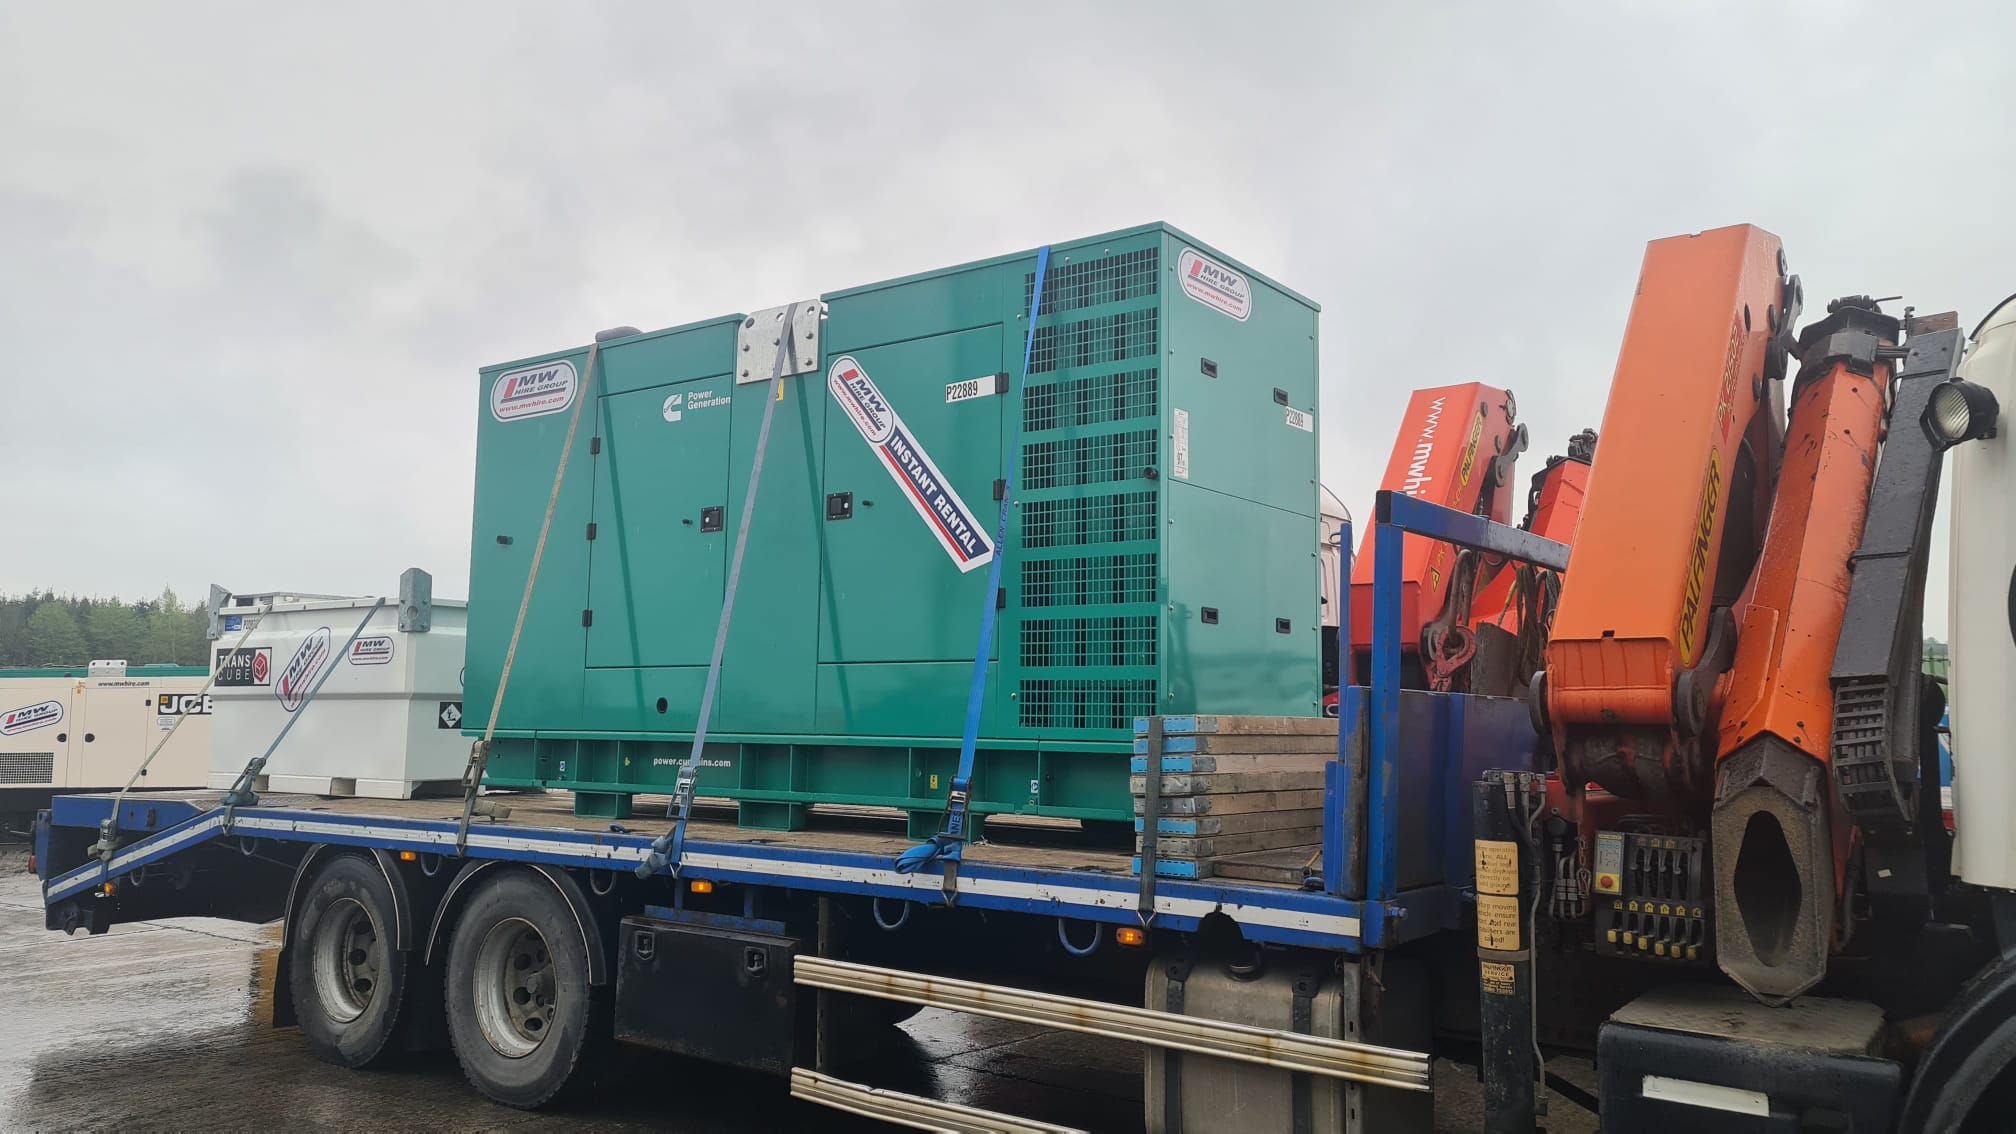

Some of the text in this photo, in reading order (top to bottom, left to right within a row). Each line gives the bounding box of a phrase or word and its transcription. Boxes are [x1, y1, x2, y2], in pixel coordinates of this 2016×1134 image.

[1203, 264, 1237, 287] MW
[1199, 274, 1245, 298] HIRE GROUP
[514, 380, 568, 396] HIRE GROUP
[518, 369, 559, 387] MW
[688, 391, 713, 400] Power
[855, 379, 887, 412] MW
[946, 381, 978, 401] P22889
[499, 396, 565, 413] www.mwhire.com
[688, 396, 731, 410] Generation
[834, 379, 877, 436] www.mwhire.com
[850, 383, 886, 429] HIRE GROUP
[1462, 416, 1481, 481] PALFINGER
[889, 435, 976, 555] INSTANT RENTAL
[1681, 458, 1721, 653] PALFINGER
[219, 654, 251, 667] TRANS
[288, 636, 314, 678] MW
[218, 669, 250, 681] CUBE
[17, 704, 50, 718] MW
[653, 758, 731, 768] power.cuins.com
